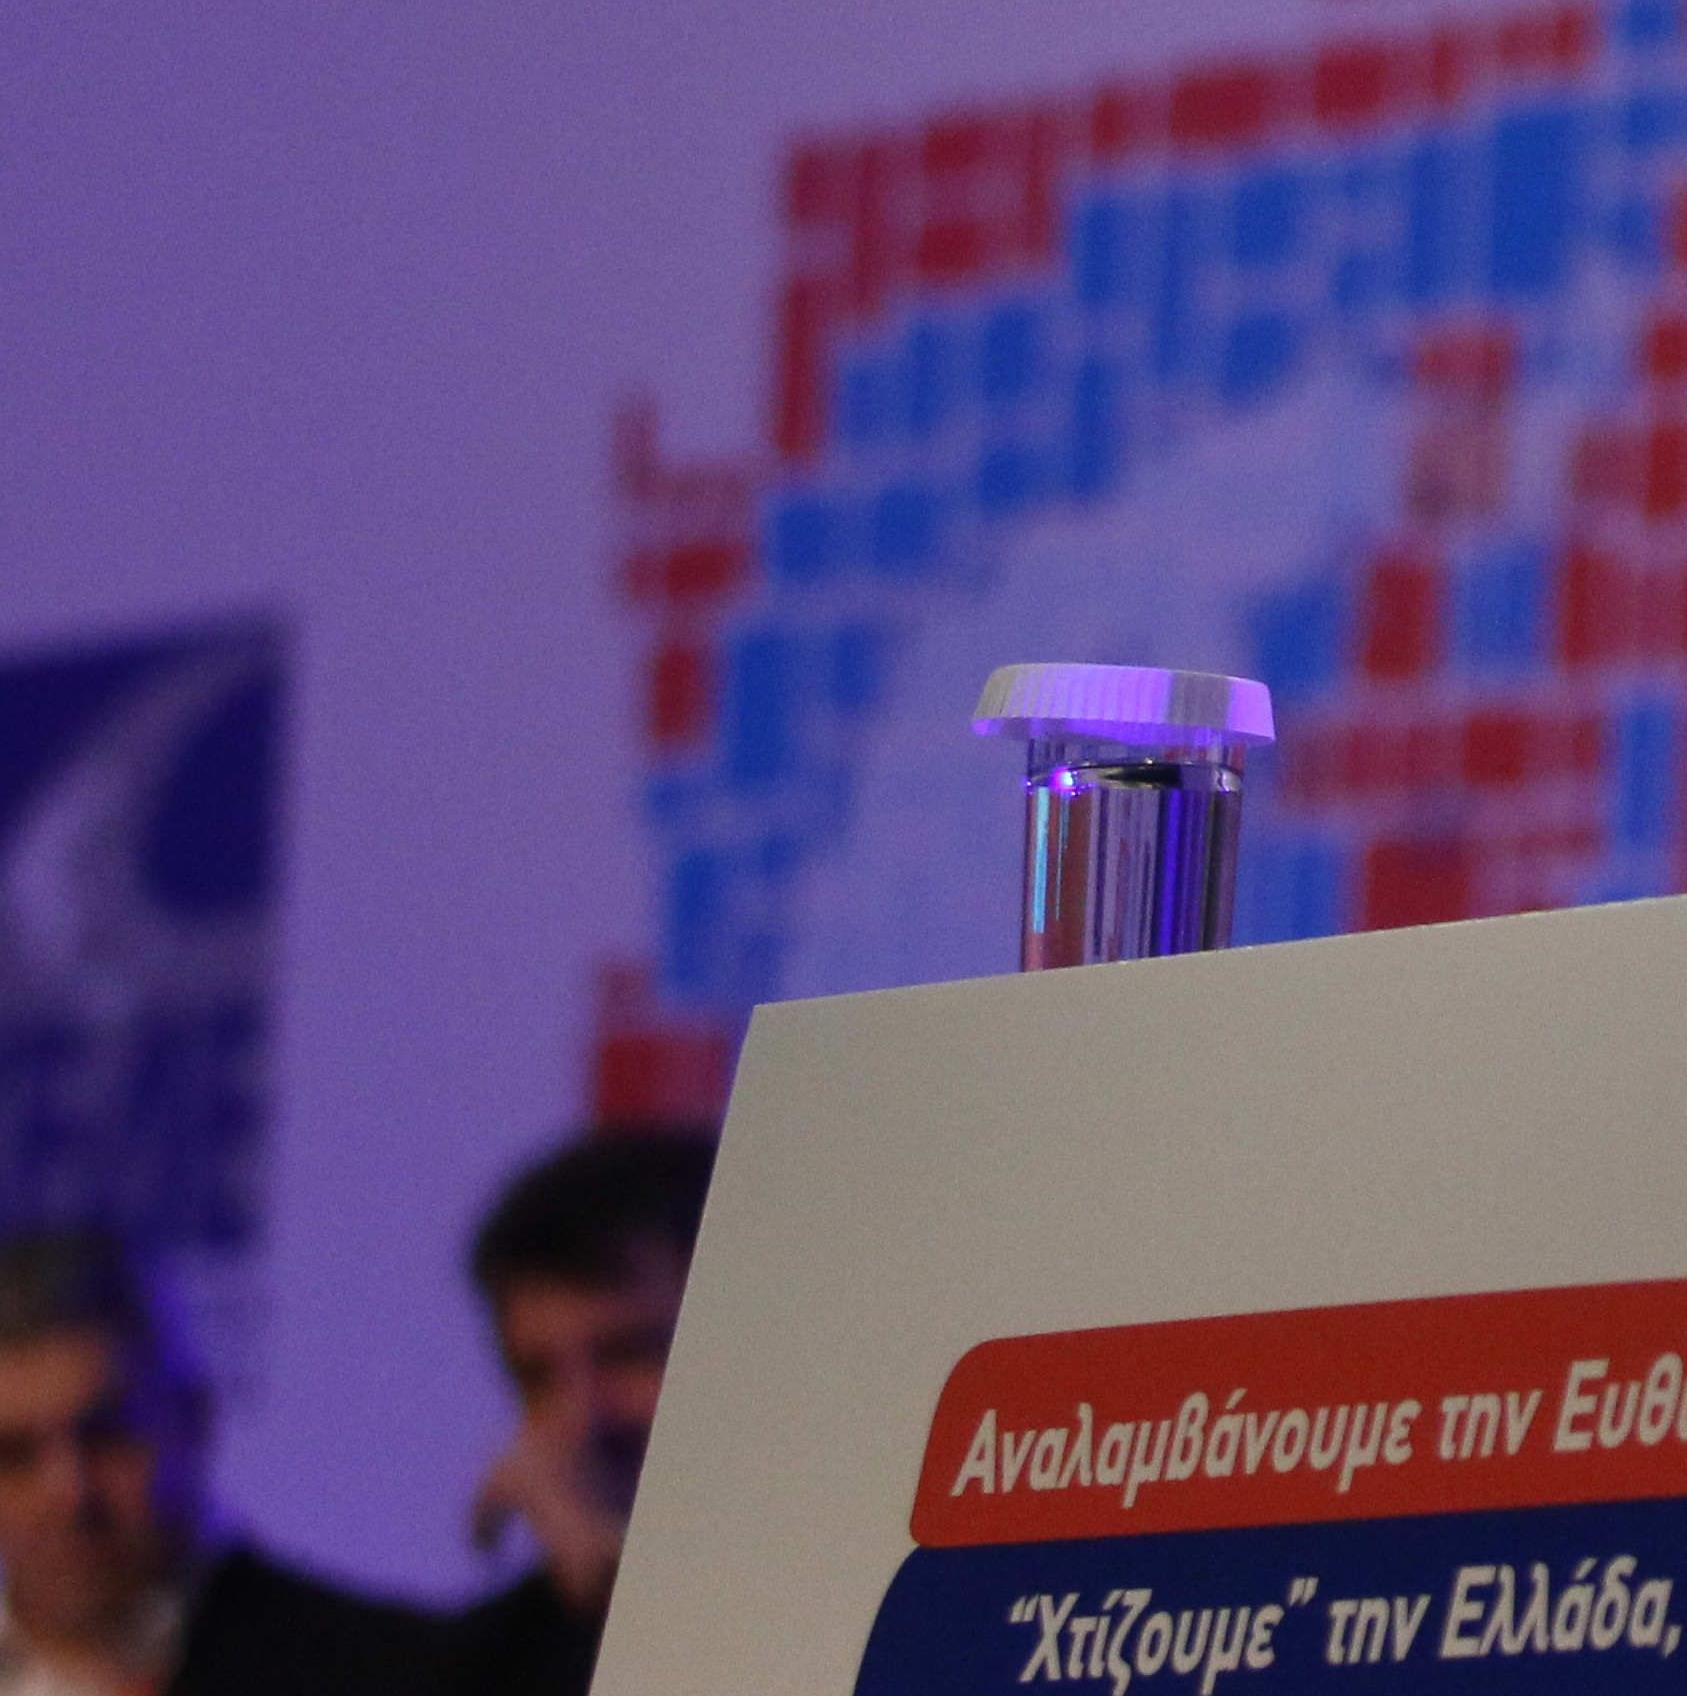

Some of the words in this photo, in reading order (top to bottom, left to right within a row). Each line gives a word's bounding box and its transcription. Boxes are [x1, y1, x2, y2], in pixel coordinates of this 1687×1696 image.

[950, 1387, 1422, 1510] Αναλαμβάνουμε
[1437, 1389, 1543, 1461] την
[1325, 1593, 1431, 1665] την
[1439, 1554, 1683, 1659] Ελλάδα,
